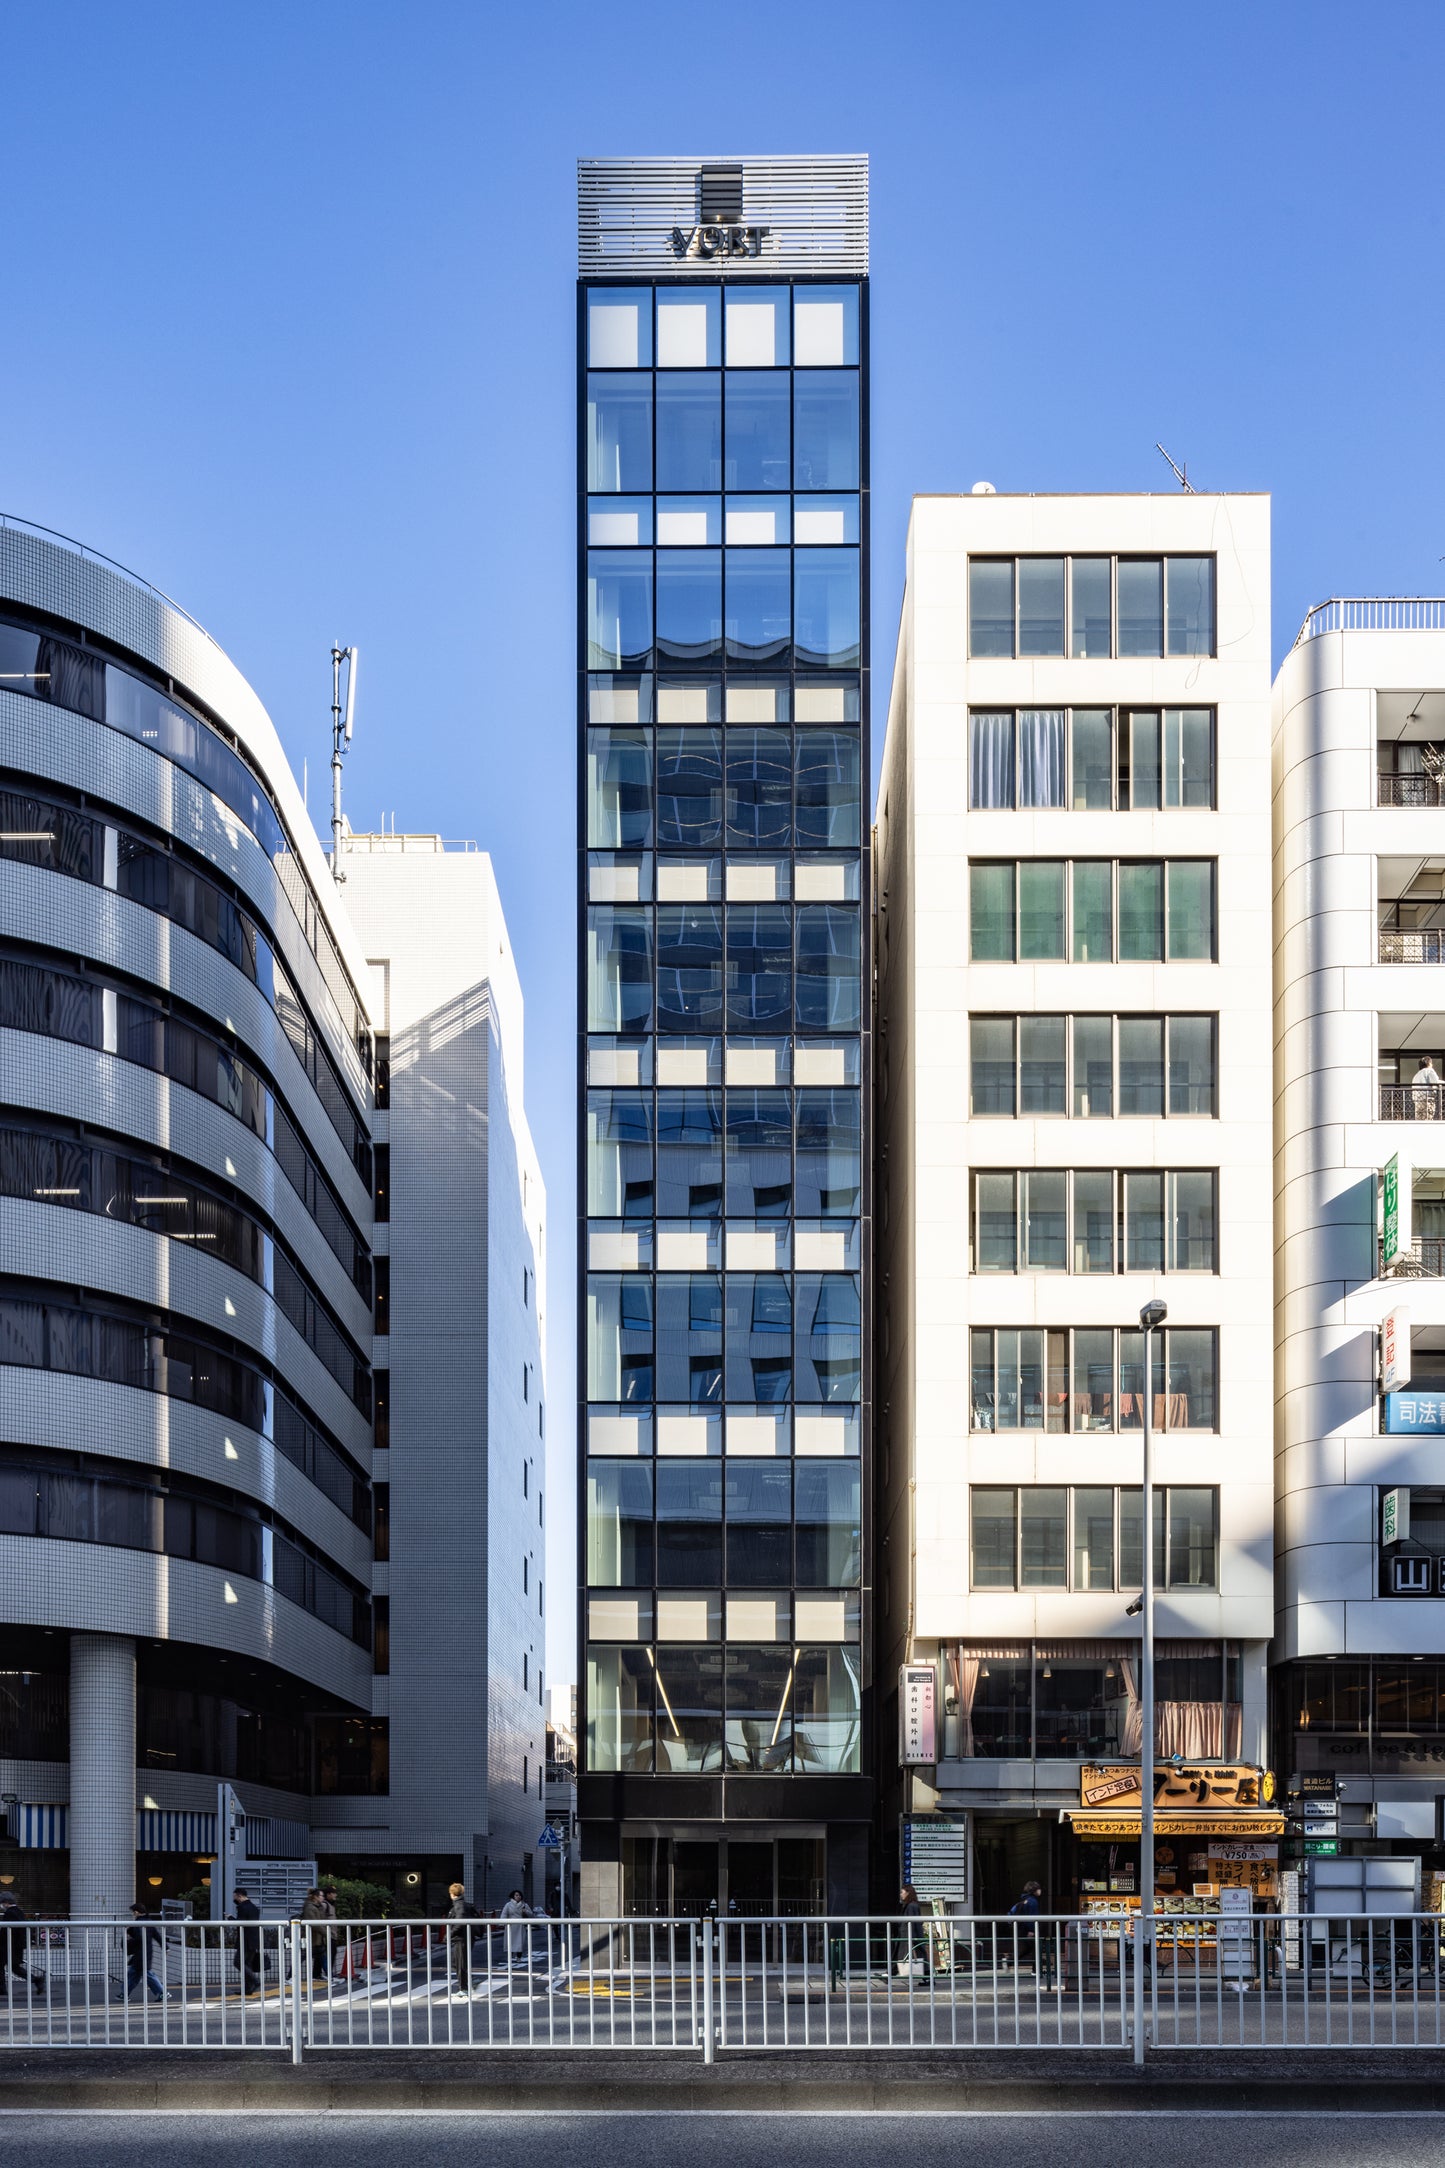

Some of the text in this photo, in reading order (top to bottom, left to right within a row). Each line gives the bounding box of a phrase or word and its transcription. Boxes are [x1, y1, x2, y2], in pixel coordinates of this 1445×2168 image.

[673, 226, 770, 257] VORT
[1385, 1168, 1398, 1258] はり整体
[1385, 1316, 1395, 1366] 登記
[1385, 1367, 1396, 1384] 4F
[1385, 1495, 1396, 1540] 歯科
[910, 1685, 919, 1747] 歯科口腔外科
[1330, 1742, 1399, 1754] cofee
[1423, 1743, 1445, 1754] te
[1089, 1779, 1135, 1800] インド定食
[1225, 1851, 1247, 1860] ¥750
